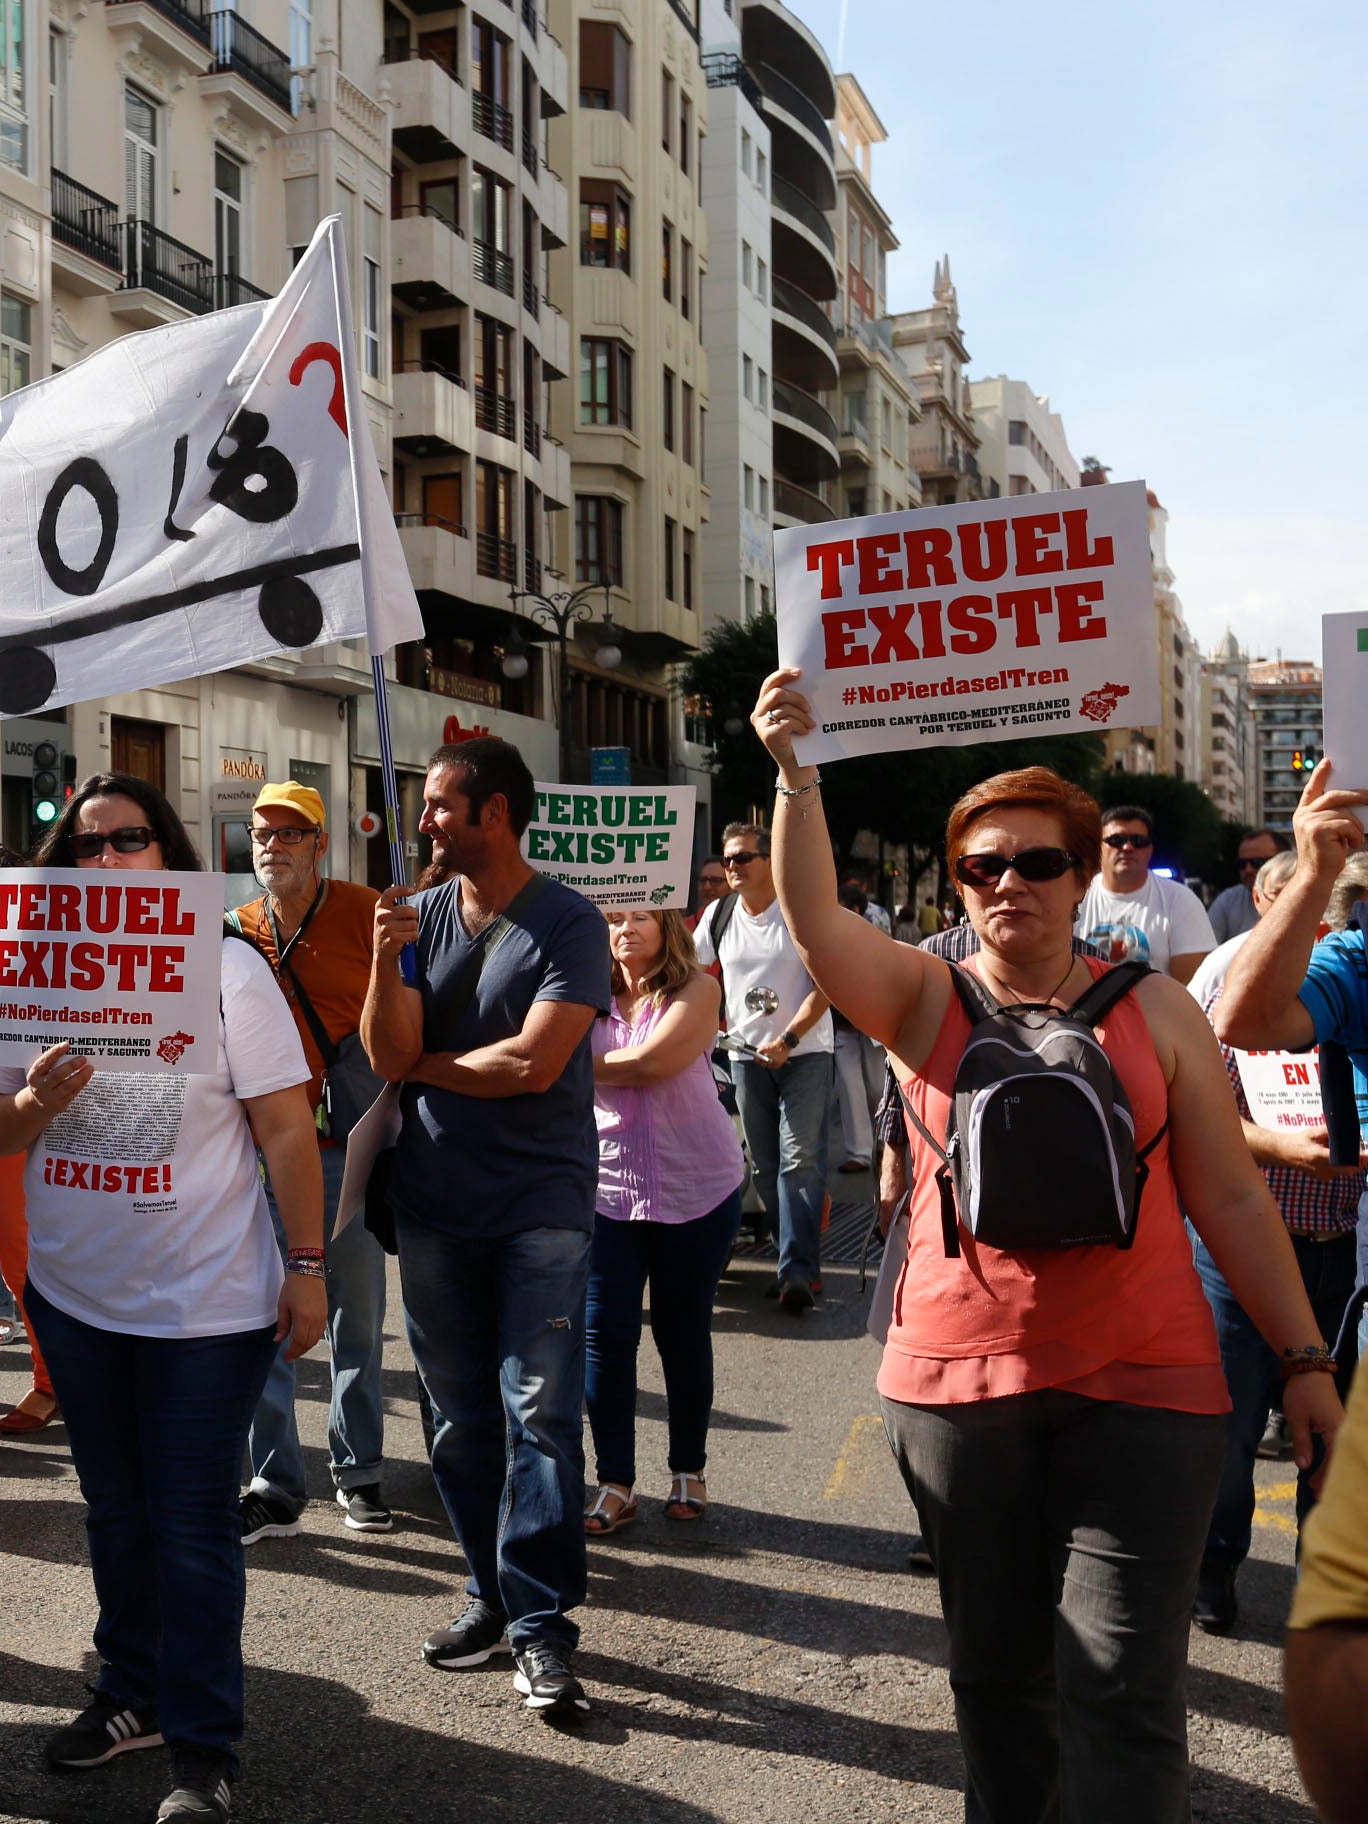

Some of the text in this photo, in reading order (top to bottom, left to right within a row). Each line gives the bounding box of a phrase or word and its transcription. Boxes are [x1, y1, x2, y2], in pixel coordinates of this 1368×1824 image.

[806, 509, 1114, 600] TERUEL
[821, 581, 1107, 670] EXISTE
[842, 668, 1070, 706] #NoPierdaselTren
[822, 718, 886, 734] CORREDOR
[919, 709, 1071, 735] POR TERUEL Y SAGUNTO
[528, 829, 670, 864] EXISTE
[539, 871, 647, 886] NoPierdaselTren
[65, 1047, 95, 1055] ERUEL
[98, 1048, 103, 1056] Y
[107, 1048, 150, 1057] SAGUNTO
[1282, 1063, 1310, 1085] EN
[44, 1157, 172, 1194] ¡EXISTE!
